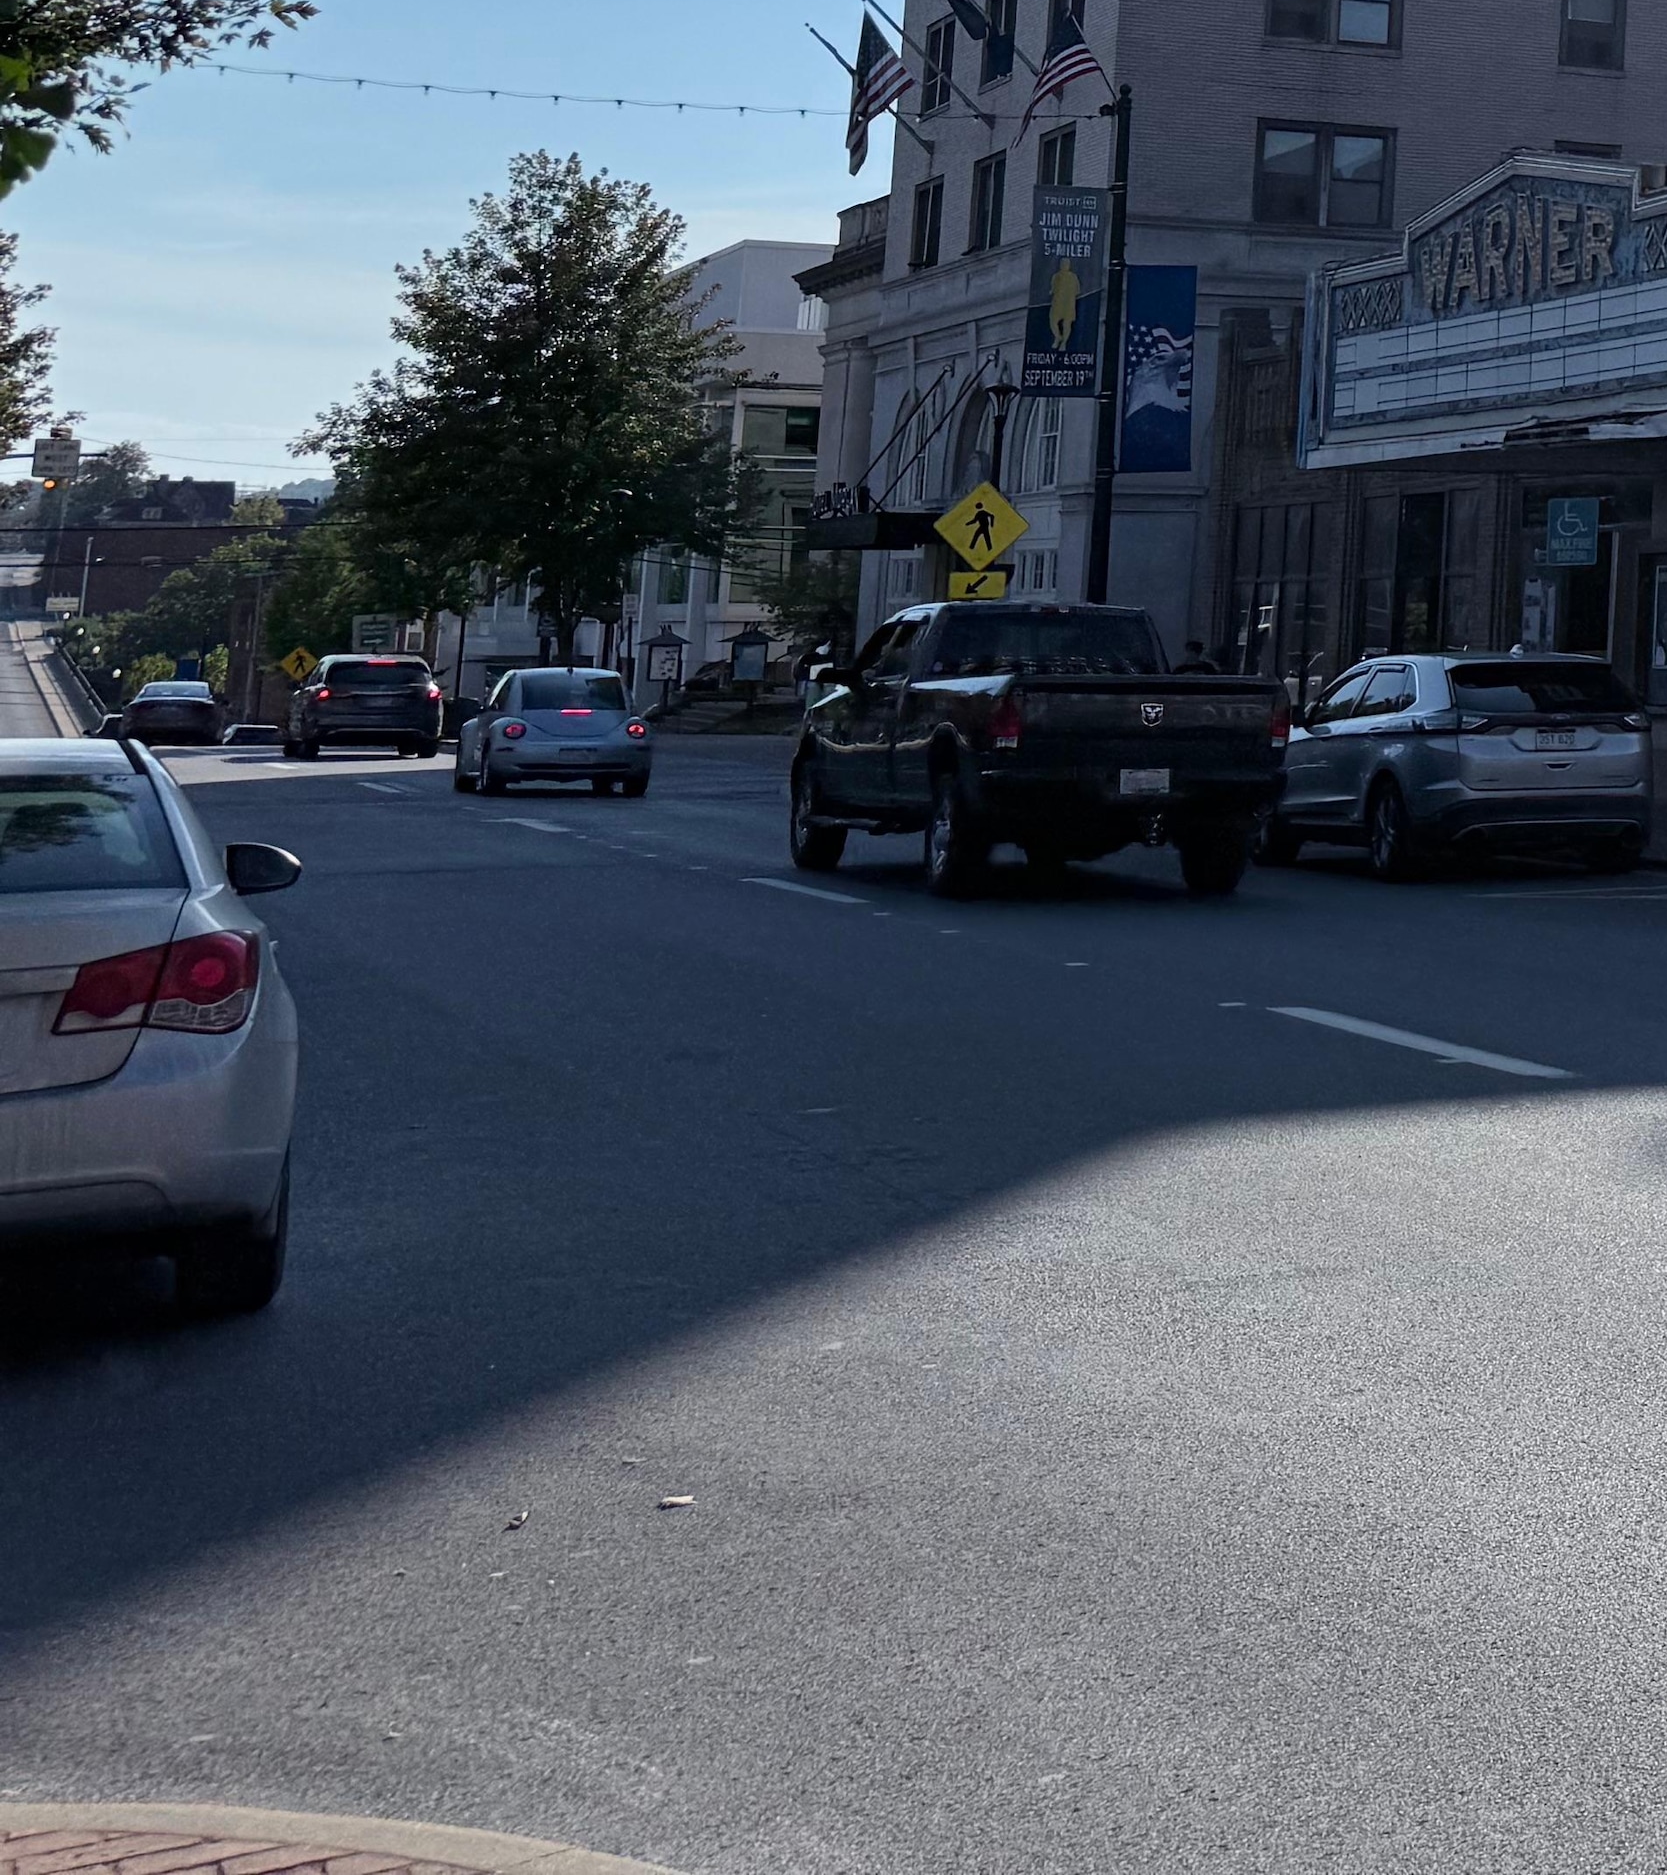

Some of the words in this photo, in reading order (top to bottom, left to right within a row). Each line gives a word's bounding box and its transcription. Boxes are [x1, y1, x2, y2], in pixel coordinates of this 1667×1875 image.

[1045, 196, 1081, 205] TRUIST
[1039, 212, 1061, 226] JIM
[1067, 214, 1099, 228] DUNN
[1042, 228, 1095, 242] TWILIGHT
[1044, 243, 1091, 257] 5-MILER
[1421, 193, 1614, 310] WARNER
[1027, 353, 1057, 364] FRIDAY
[1024, 370, 1073, 386] SEPTEMBER
